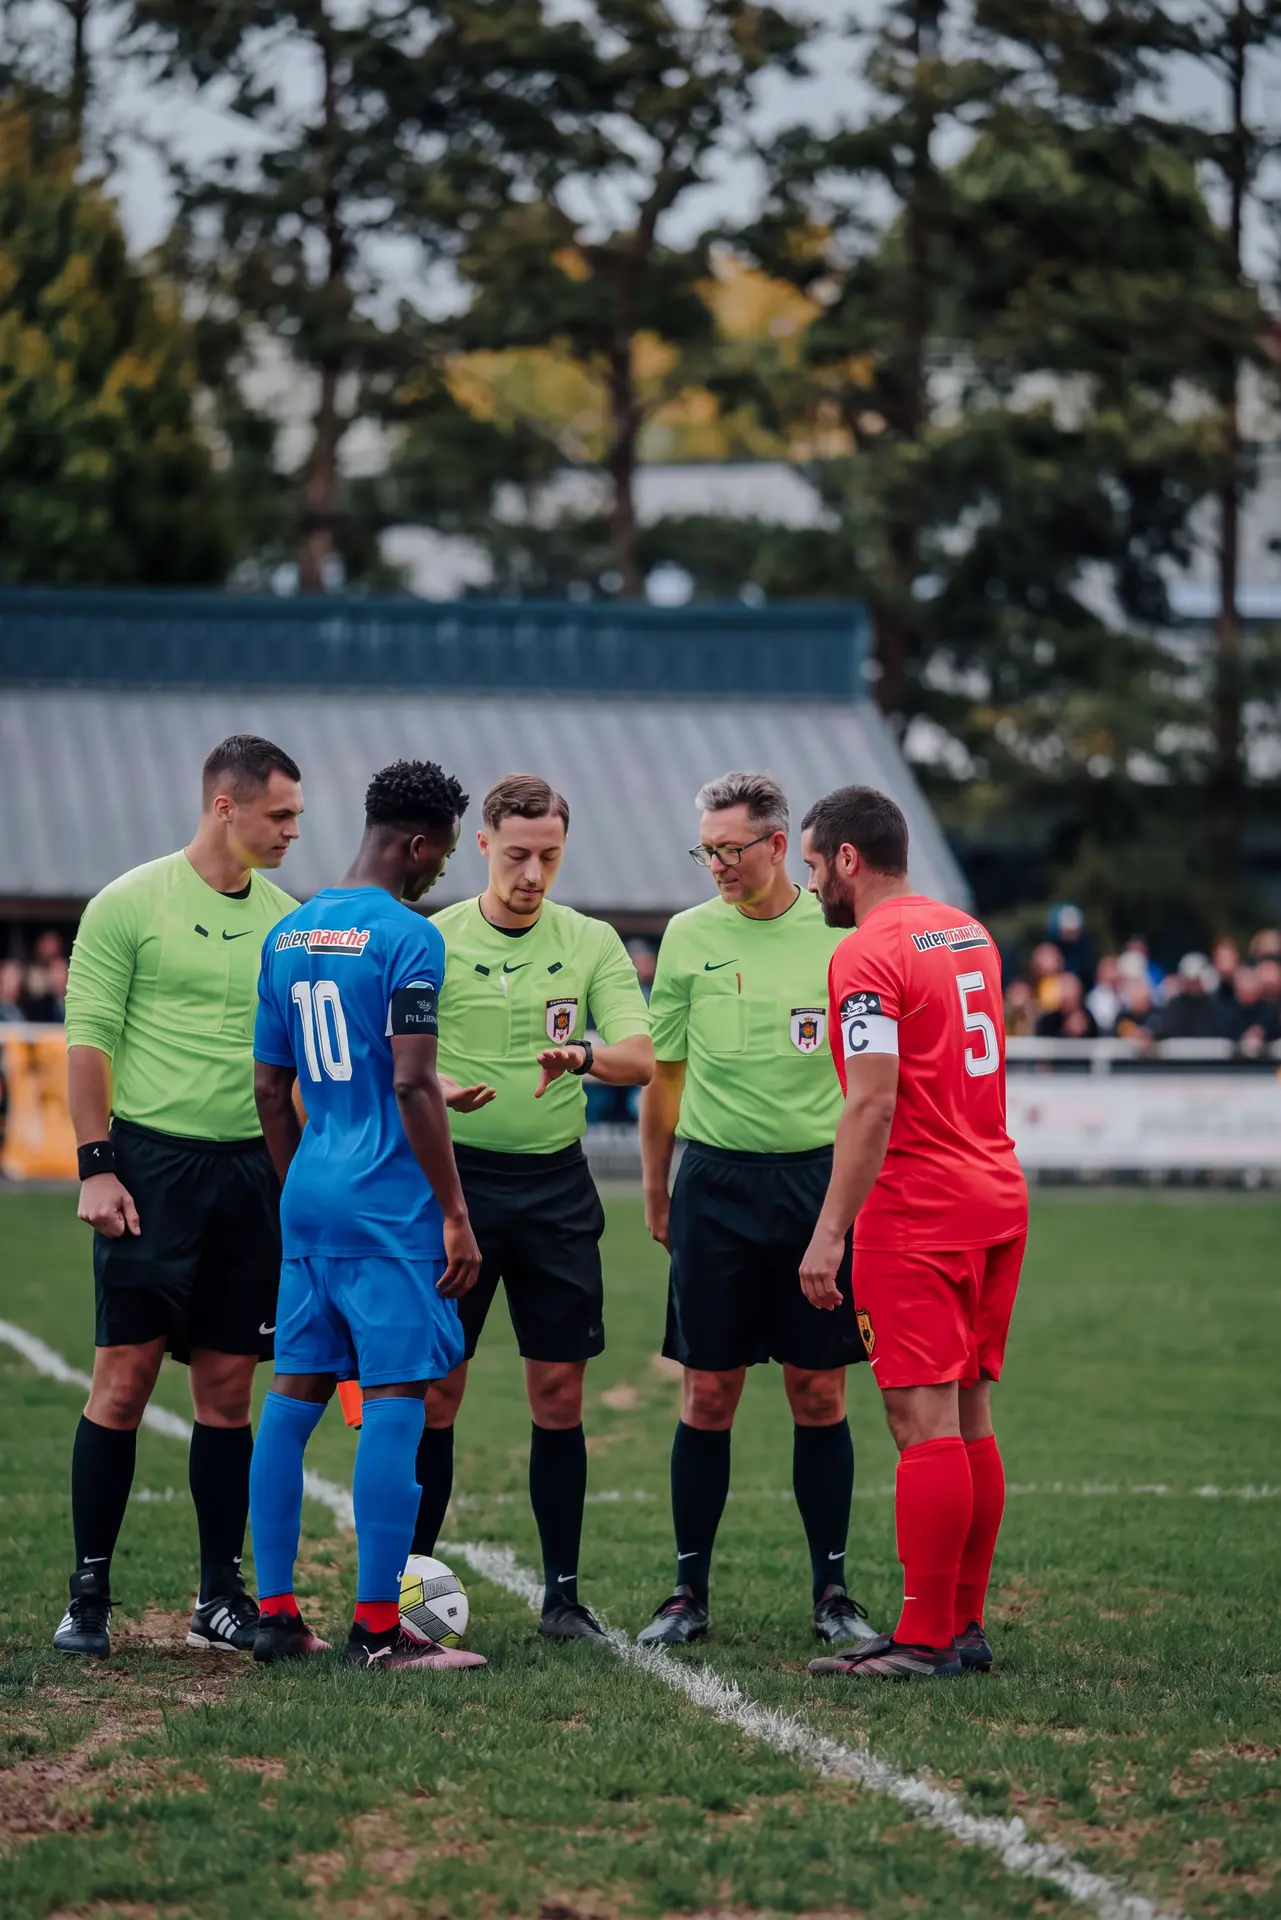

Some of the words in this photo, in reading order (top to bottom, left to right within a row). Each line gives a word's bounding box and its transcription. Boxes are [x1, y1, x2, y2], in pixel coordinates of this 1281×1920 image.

[911, 922, 987, 952] Intermar
[291, 980, 353, 1082] 10
[848, 1019, 870, 1052] C
[956, 970, 999, 1077] 5
